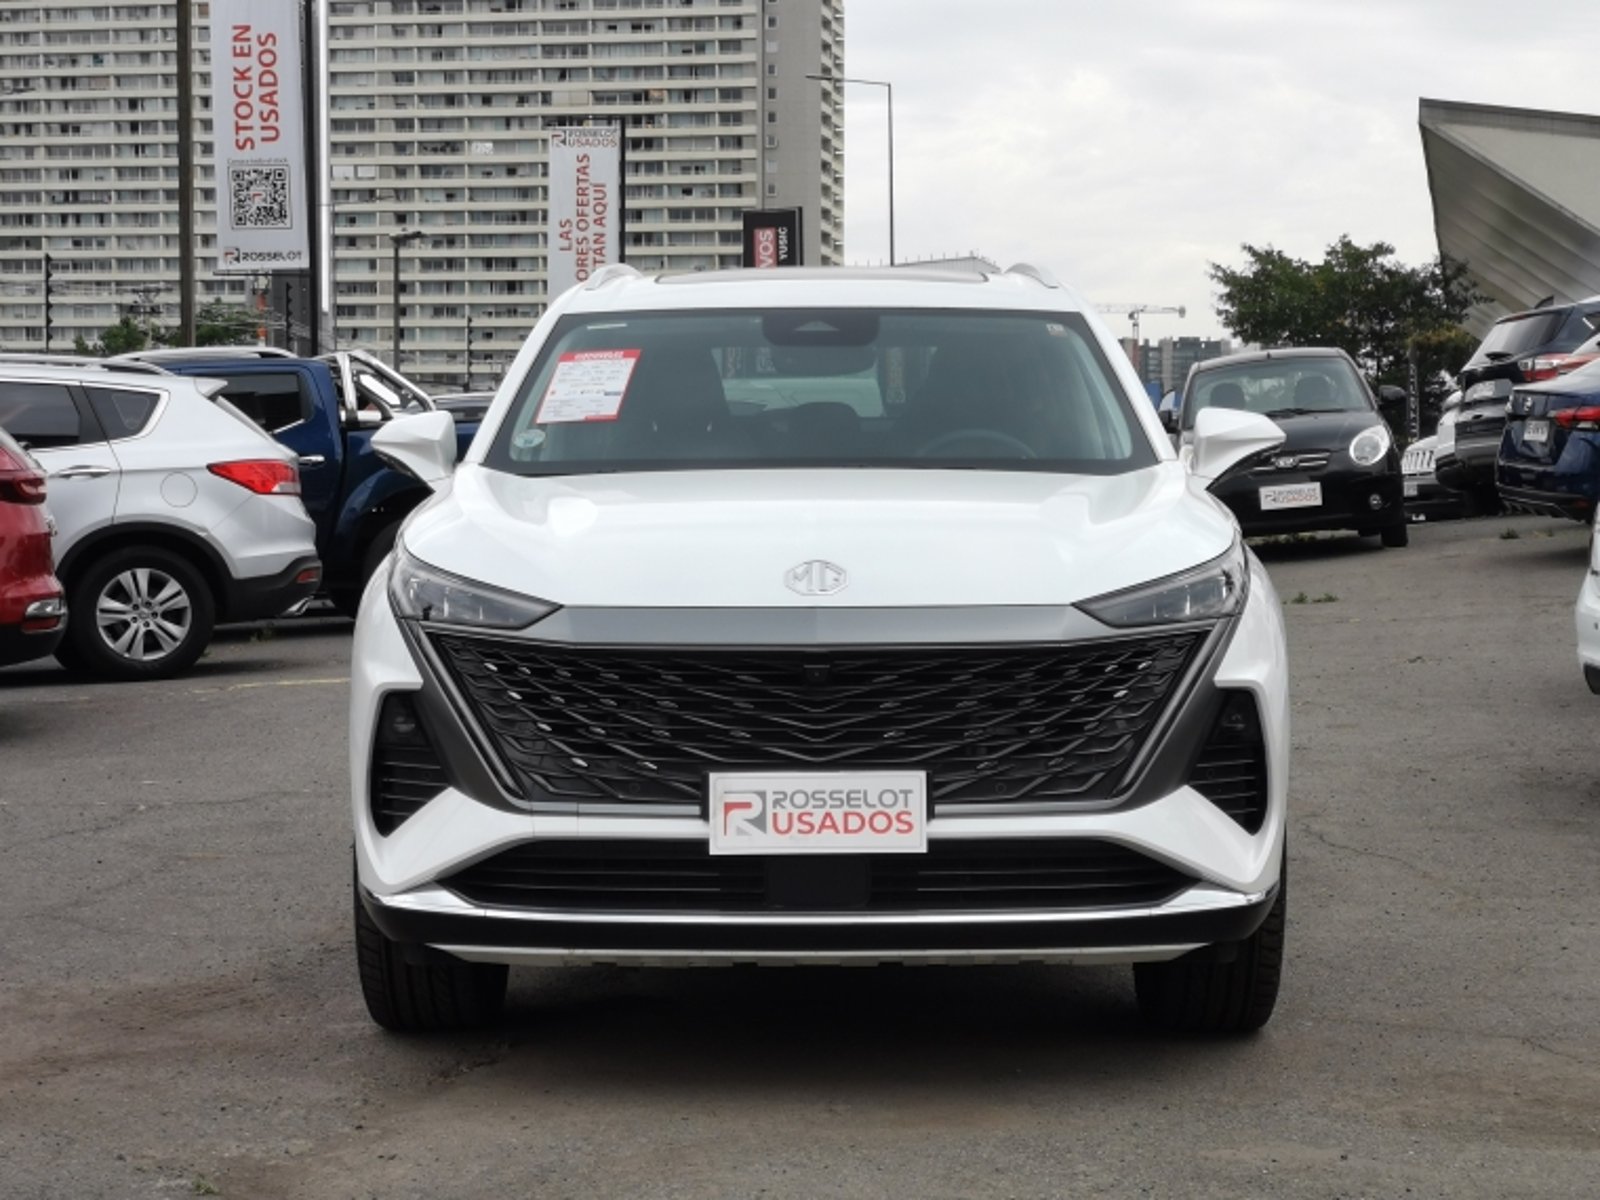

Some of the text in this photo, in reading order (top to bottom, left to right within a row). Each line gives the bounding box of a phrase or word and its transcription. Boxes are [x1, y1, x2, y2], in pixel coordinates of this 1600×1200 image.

[232, 24, 252, 57] EN
[258, 32, 280, 143] USADOS
[233, 65, 255, 151] STOCK
[568, 137, 618, 148] USADOS
[576, 153, 590, 282] ORES OFERTAS
[590, 182, 608, 270] TÁN AQUÍ
[559, 218, 573, 252] LAS
[759, 230, 773, 268] VOS
[242, 251, 303, 262] ROSSELOT
[791, 560, 844, 593] MG
[772, 789, 914, 809] ROSSELOT
[772, 810, 914, 835] USADOS
